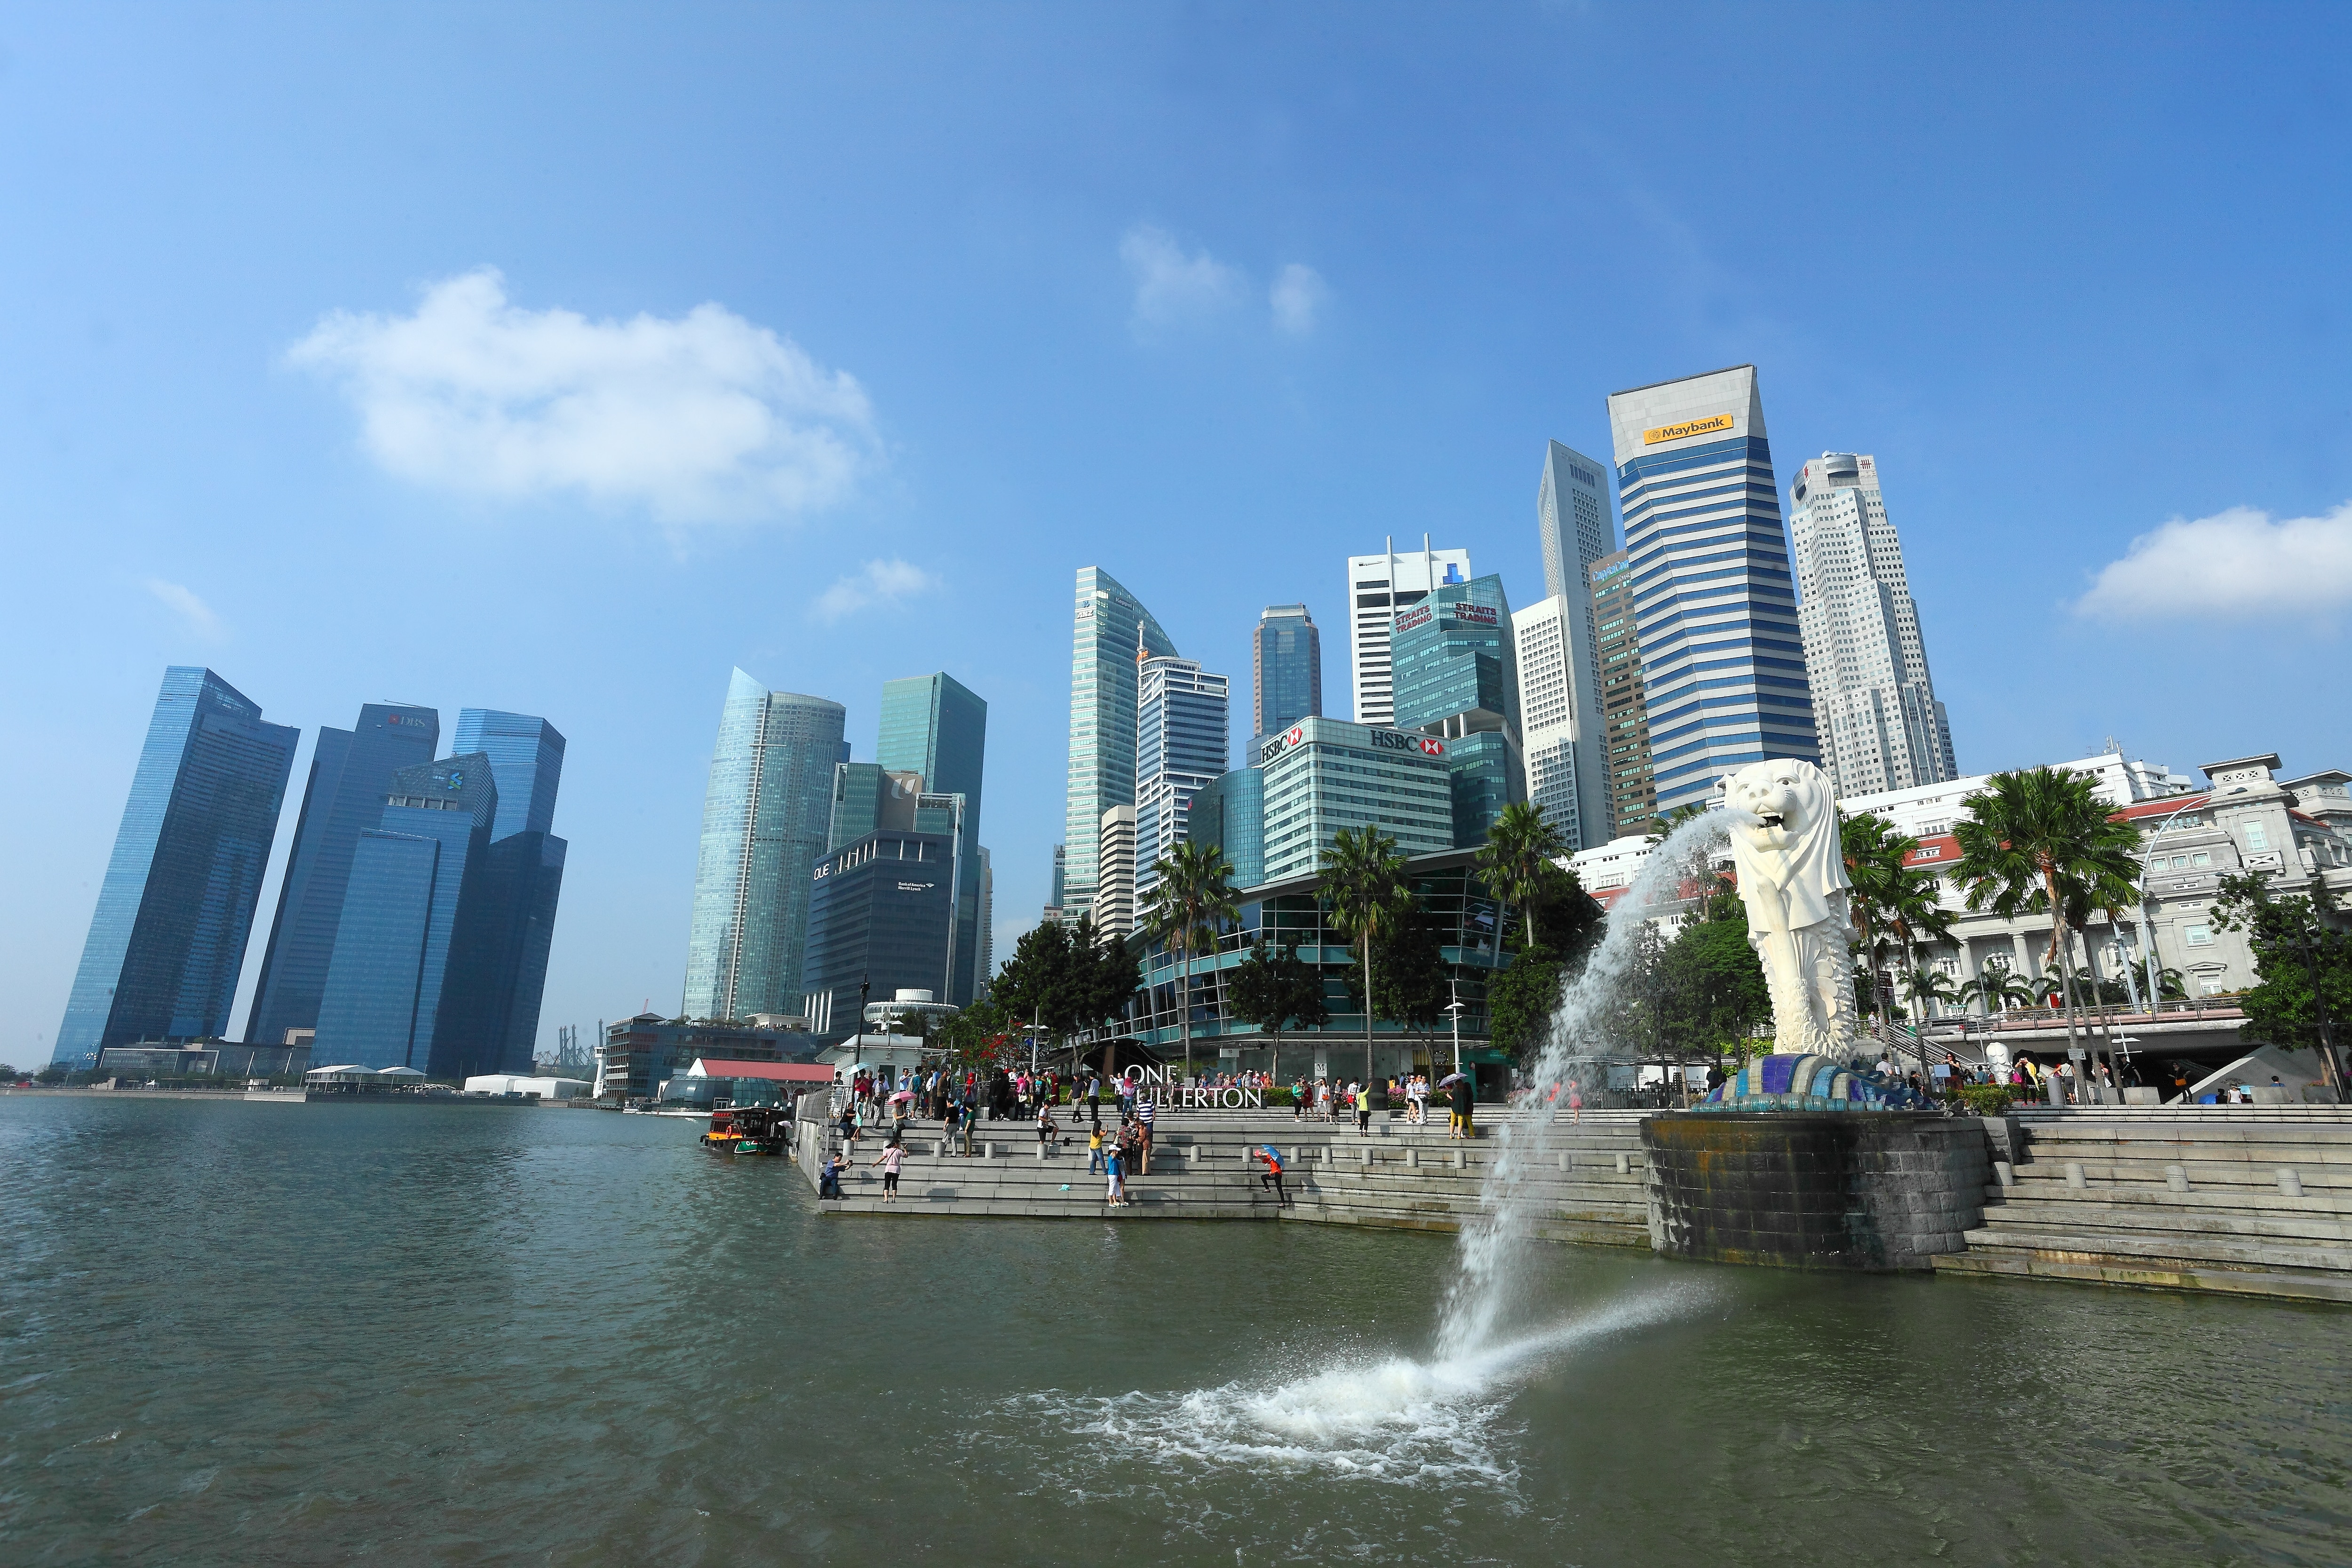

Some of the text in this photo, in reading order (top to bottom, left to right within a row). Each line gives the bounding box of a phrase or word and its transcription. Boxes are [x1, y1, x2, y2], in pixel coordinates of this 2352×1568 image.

[1662, 418, 1724, 438] Maybank
[1115, 597, 1132, 608] Keppel
[1456, 603, 1496, 615] STRAITS
[1077, 610, 1094, 619] ANZ
[1395, 605, 1430, 625] STRAITS
[1396, 613, 1432, 634] TRADING
[1454, 611, 1497, 625] TRADING
[401, 716, 426, 727] DBS
[1261, 735, 1287, 763] HSBC
[1370, 730, 1418, 751] HSBC
[814, 863, 830, 881] OUE
[1124, 1064, 1177, 1084] ONE
